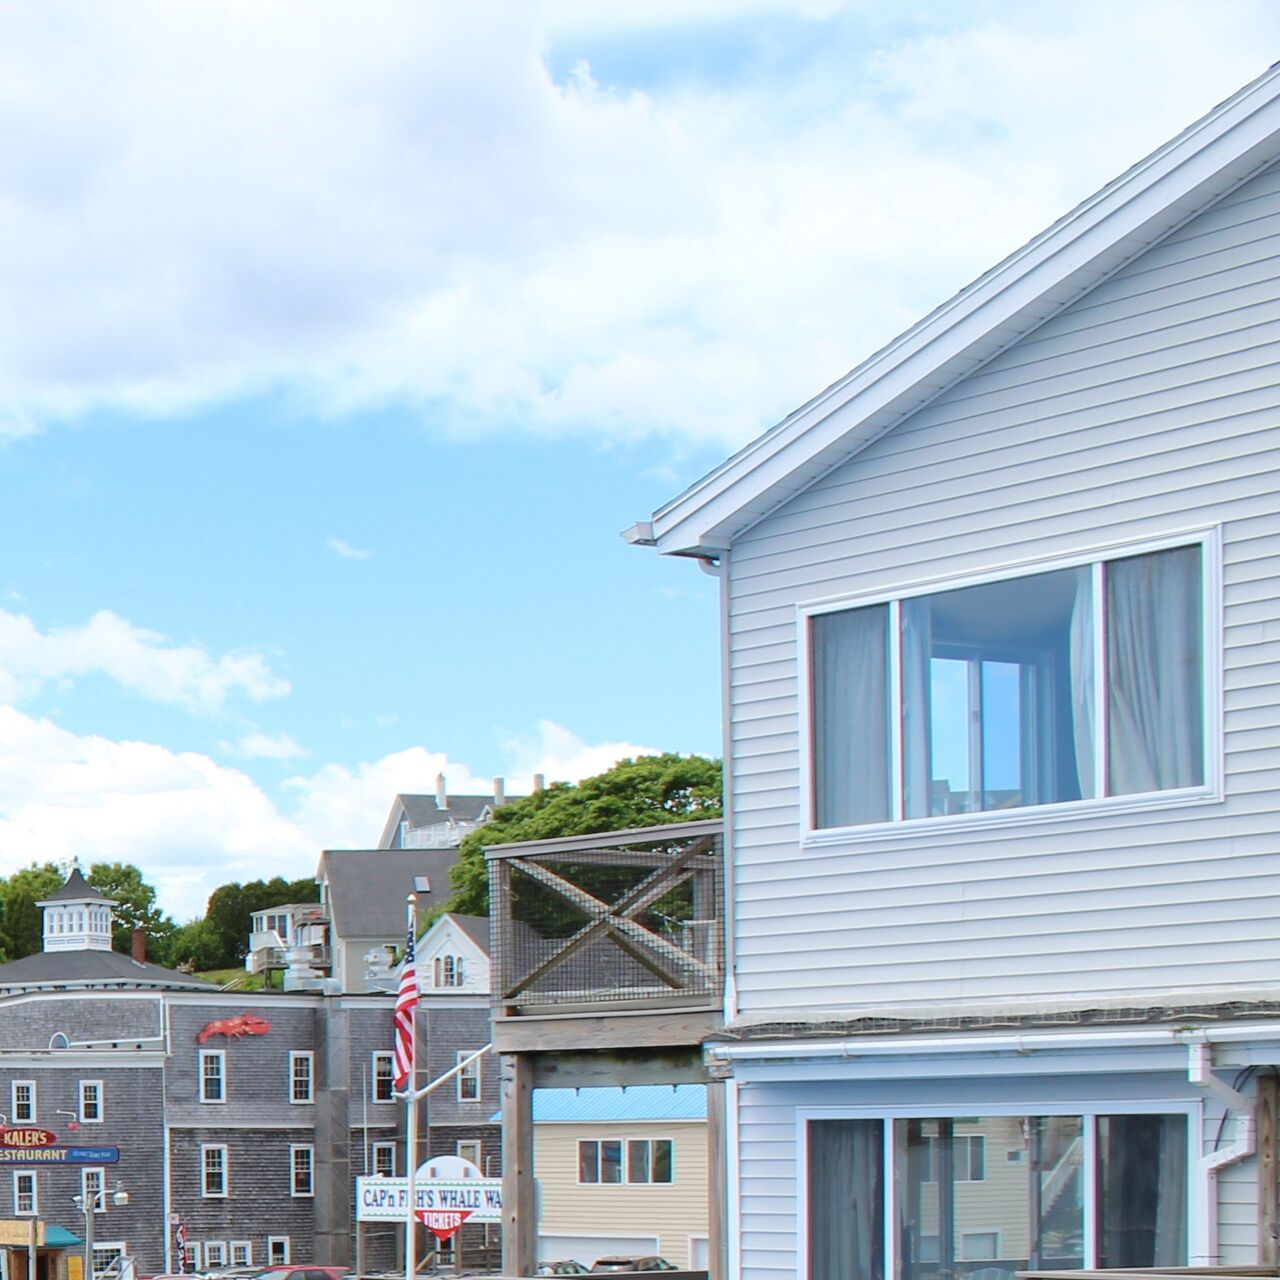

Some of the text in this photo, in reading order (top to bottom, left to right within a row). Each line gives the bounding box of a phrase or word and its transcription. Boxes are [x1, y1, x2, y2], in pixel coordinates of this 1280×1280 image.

[3, 1130, 47, 1147] KALER'S
[439, 1189, 481, 1208] WHALE
[423, 1212, 462, 1229] TICKETS
